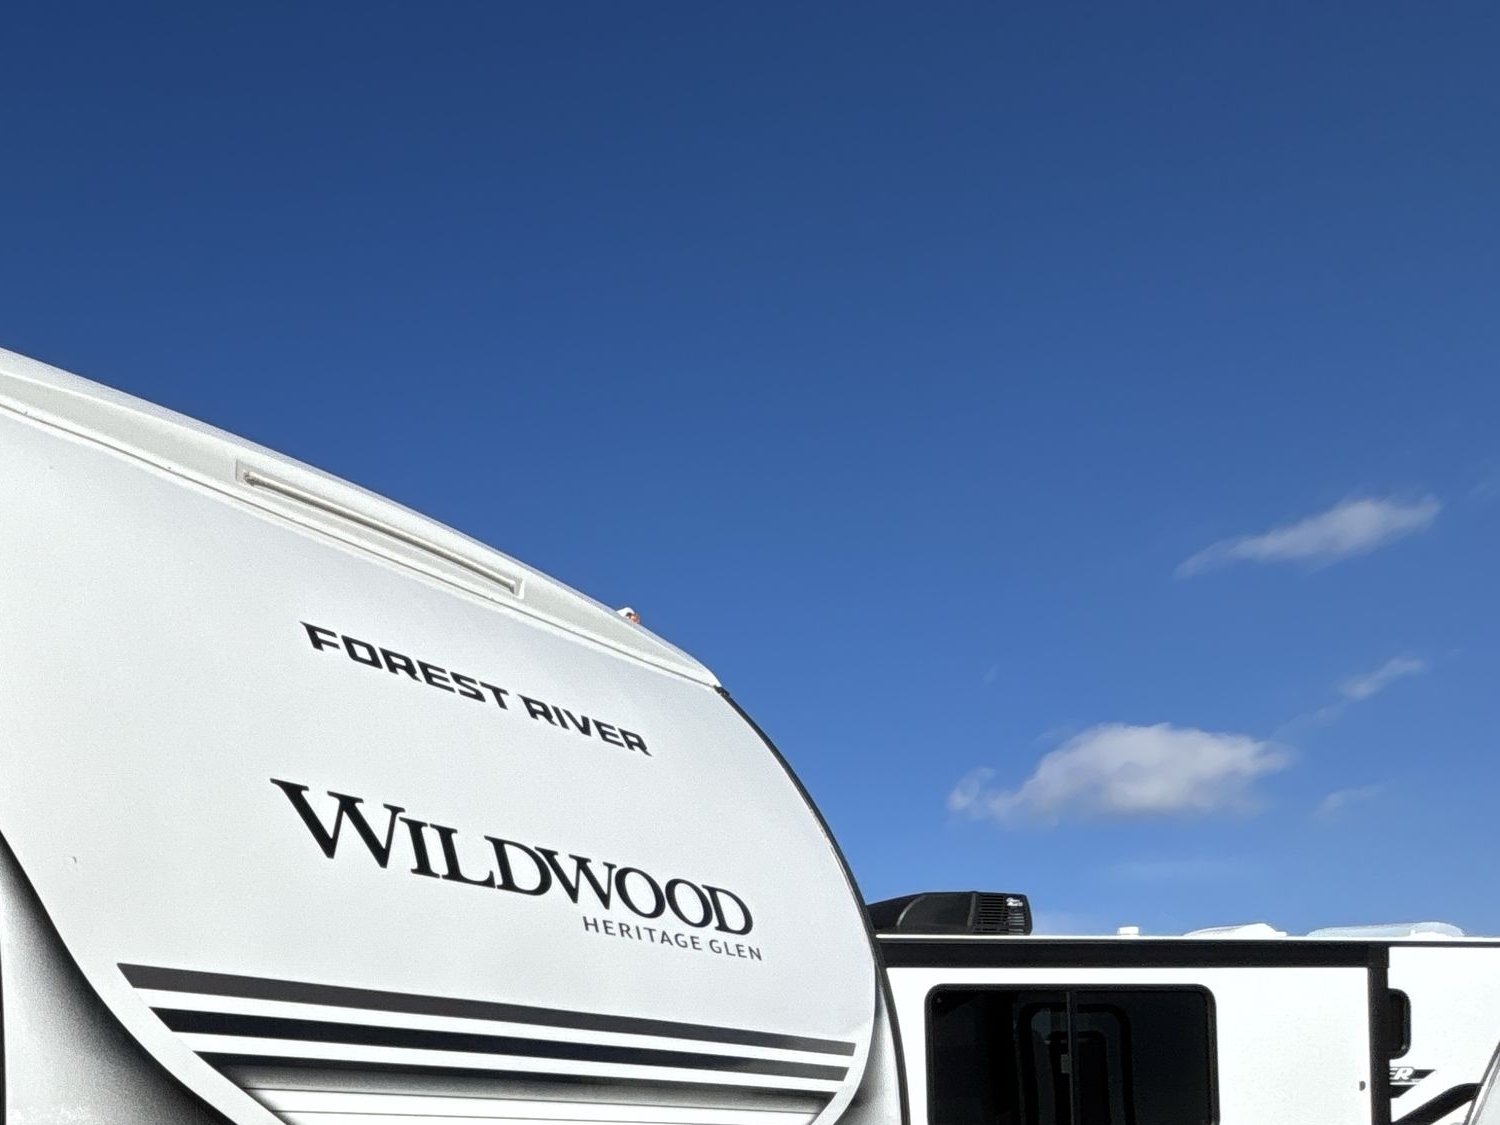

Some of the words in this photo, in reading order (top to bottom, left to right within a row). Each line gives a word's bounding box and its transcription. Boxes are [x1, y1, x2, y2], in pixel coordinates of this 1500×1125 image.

[301, 621, 509, 711] FOREST
[518, 693, 653, 757] RIVER
[270, 778, 754, 936] WILDWOOD
[583, 916, 702, 951] HERITAGE
[709, 939, 762, 961] GLEN
